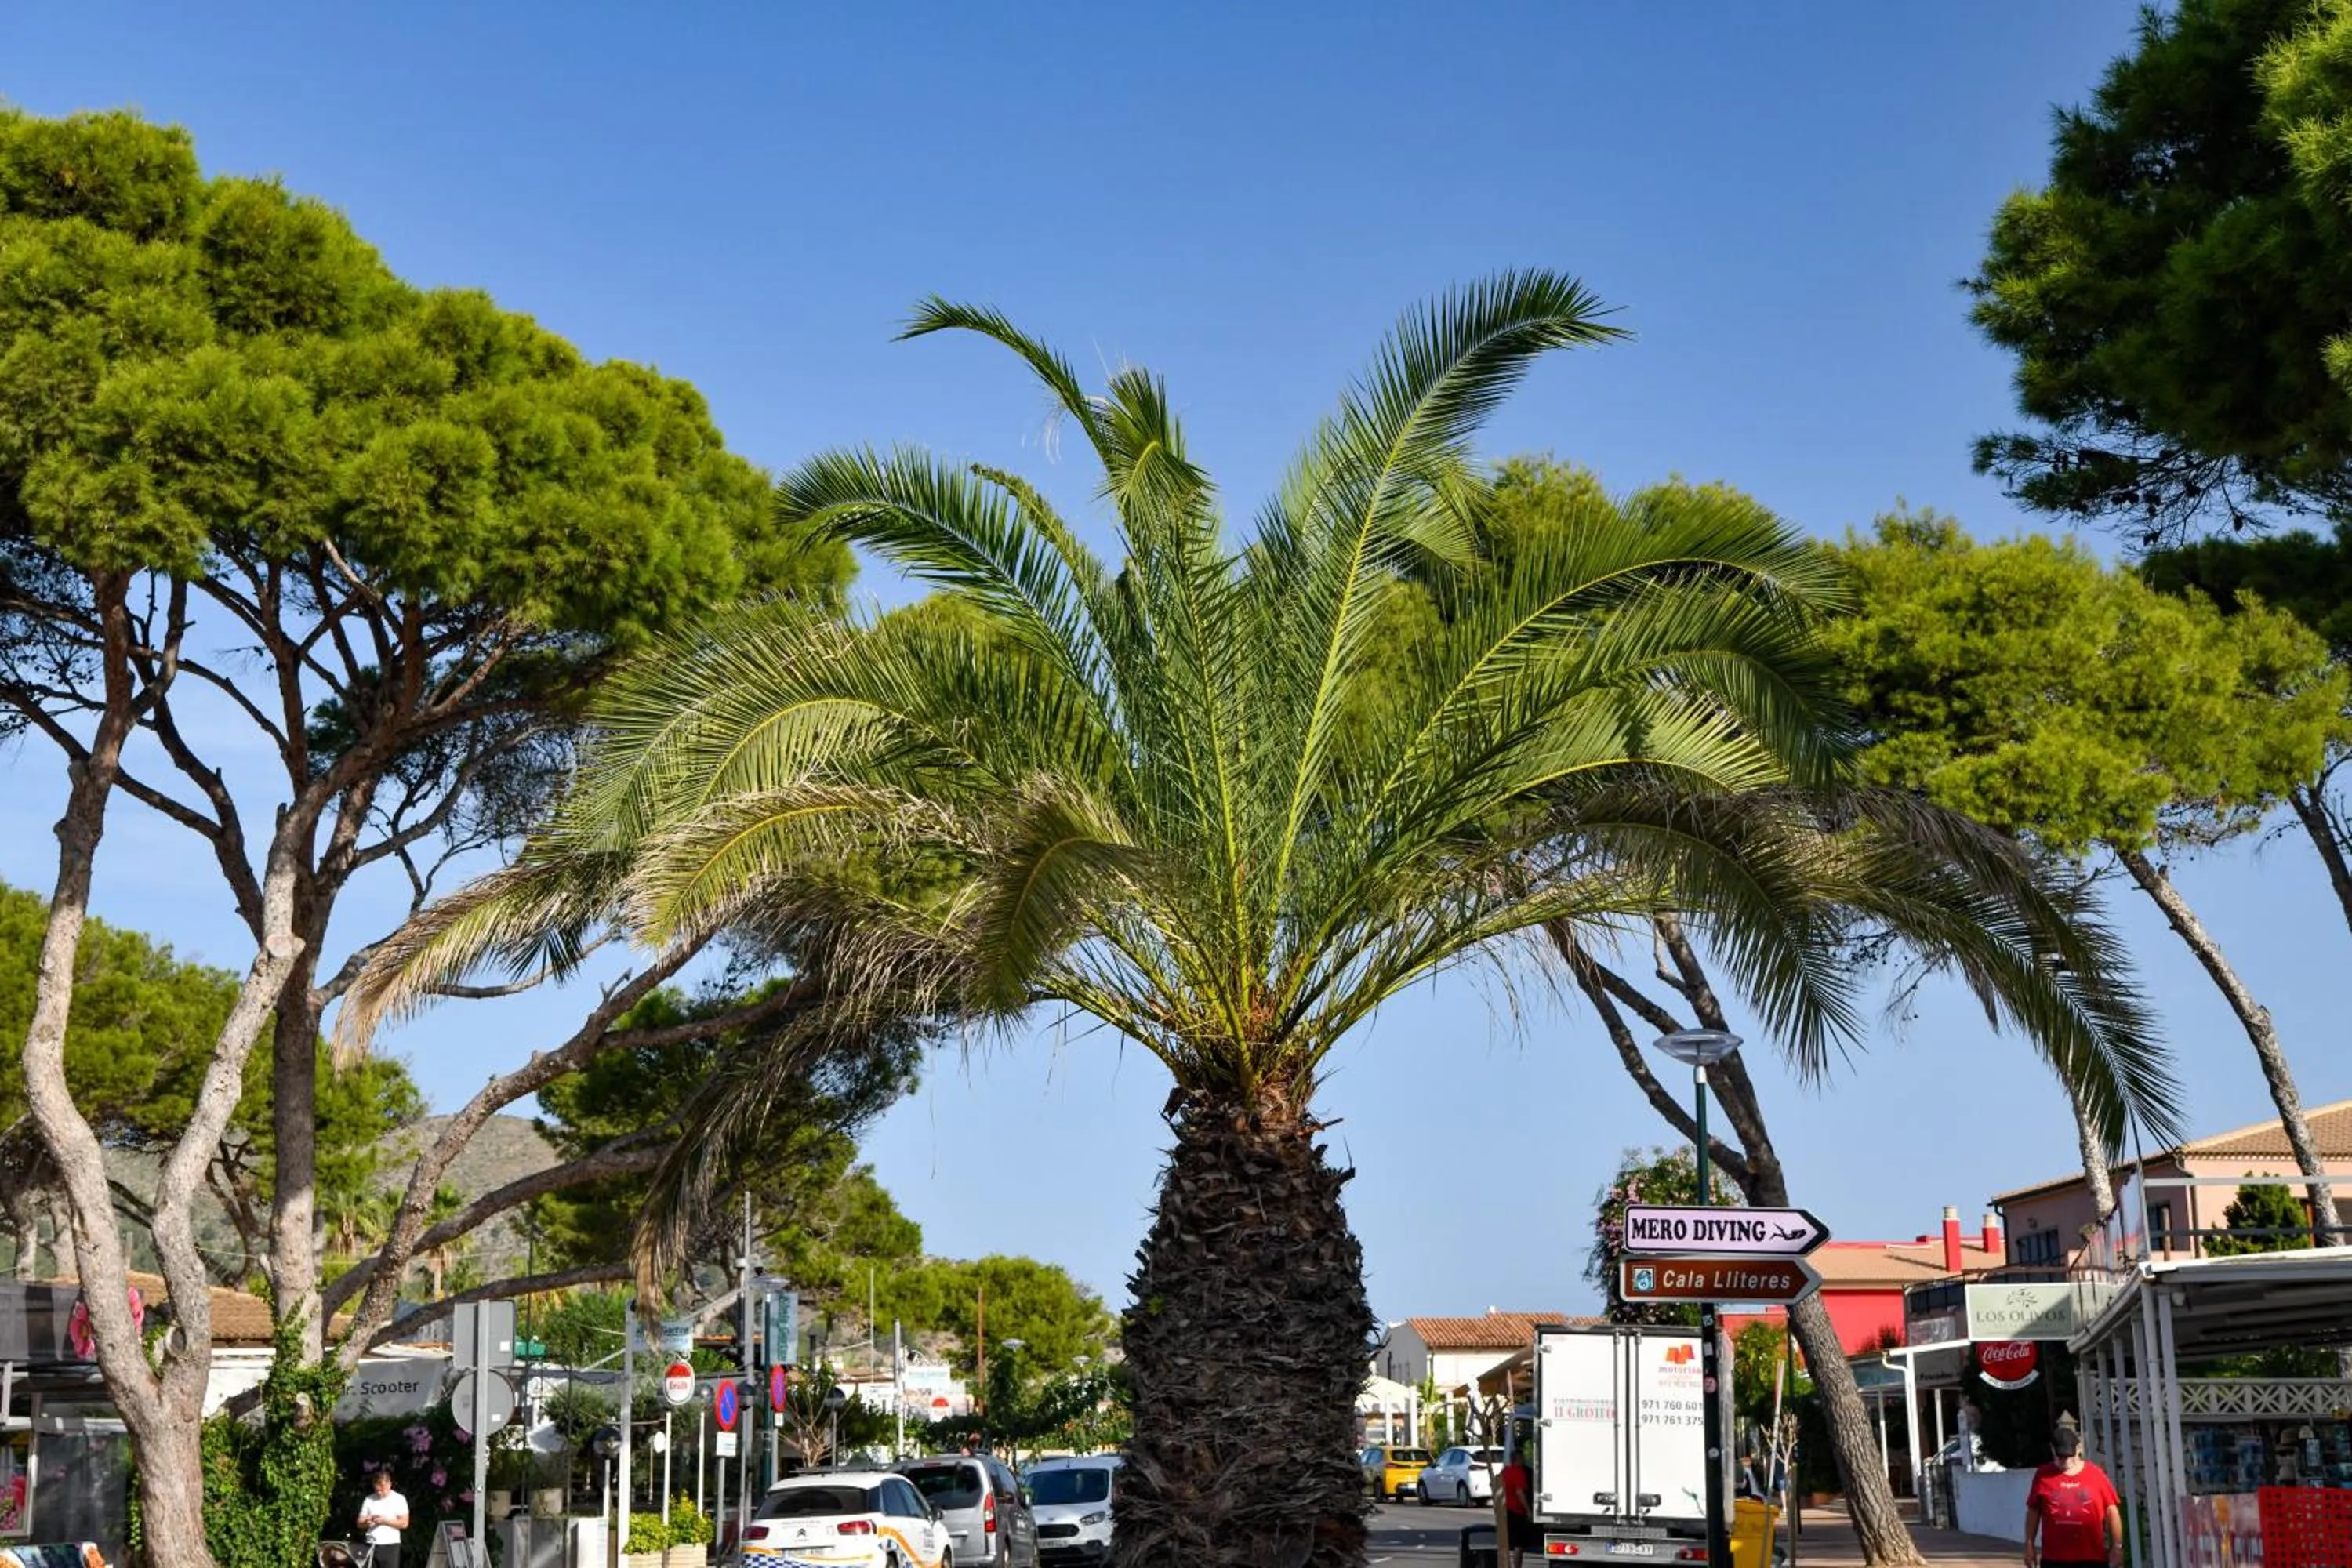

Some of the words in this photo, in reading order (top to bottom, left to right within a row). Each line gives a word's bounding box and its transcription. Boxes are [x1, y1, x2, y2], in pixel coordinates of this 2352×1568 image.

[1632, 1218, 1686, 1240] MERO
[1693, 1219, 1766, 1242] DIVING
[1663, 1269, 1705, 1288] Cala
[1714, 1271, 1791, 1289] Lliteres
[1976, 1310, 2005, 1322] LOS
[2009, 1309, 2066, 1322] OLIVOS
[1983, 1340, 2032, 1364] Coca-Cola
[360, 1381, 419, 1395] Scooter
[1641, 1399, 1660, 1410] 971
[1664, 1401, 1682, 1410] 760
[1685, 1401, 1703, 1411] 601
[1641, 1414, 1660, 1424] 971
[1686, 1415, 1704, 1425] 375
